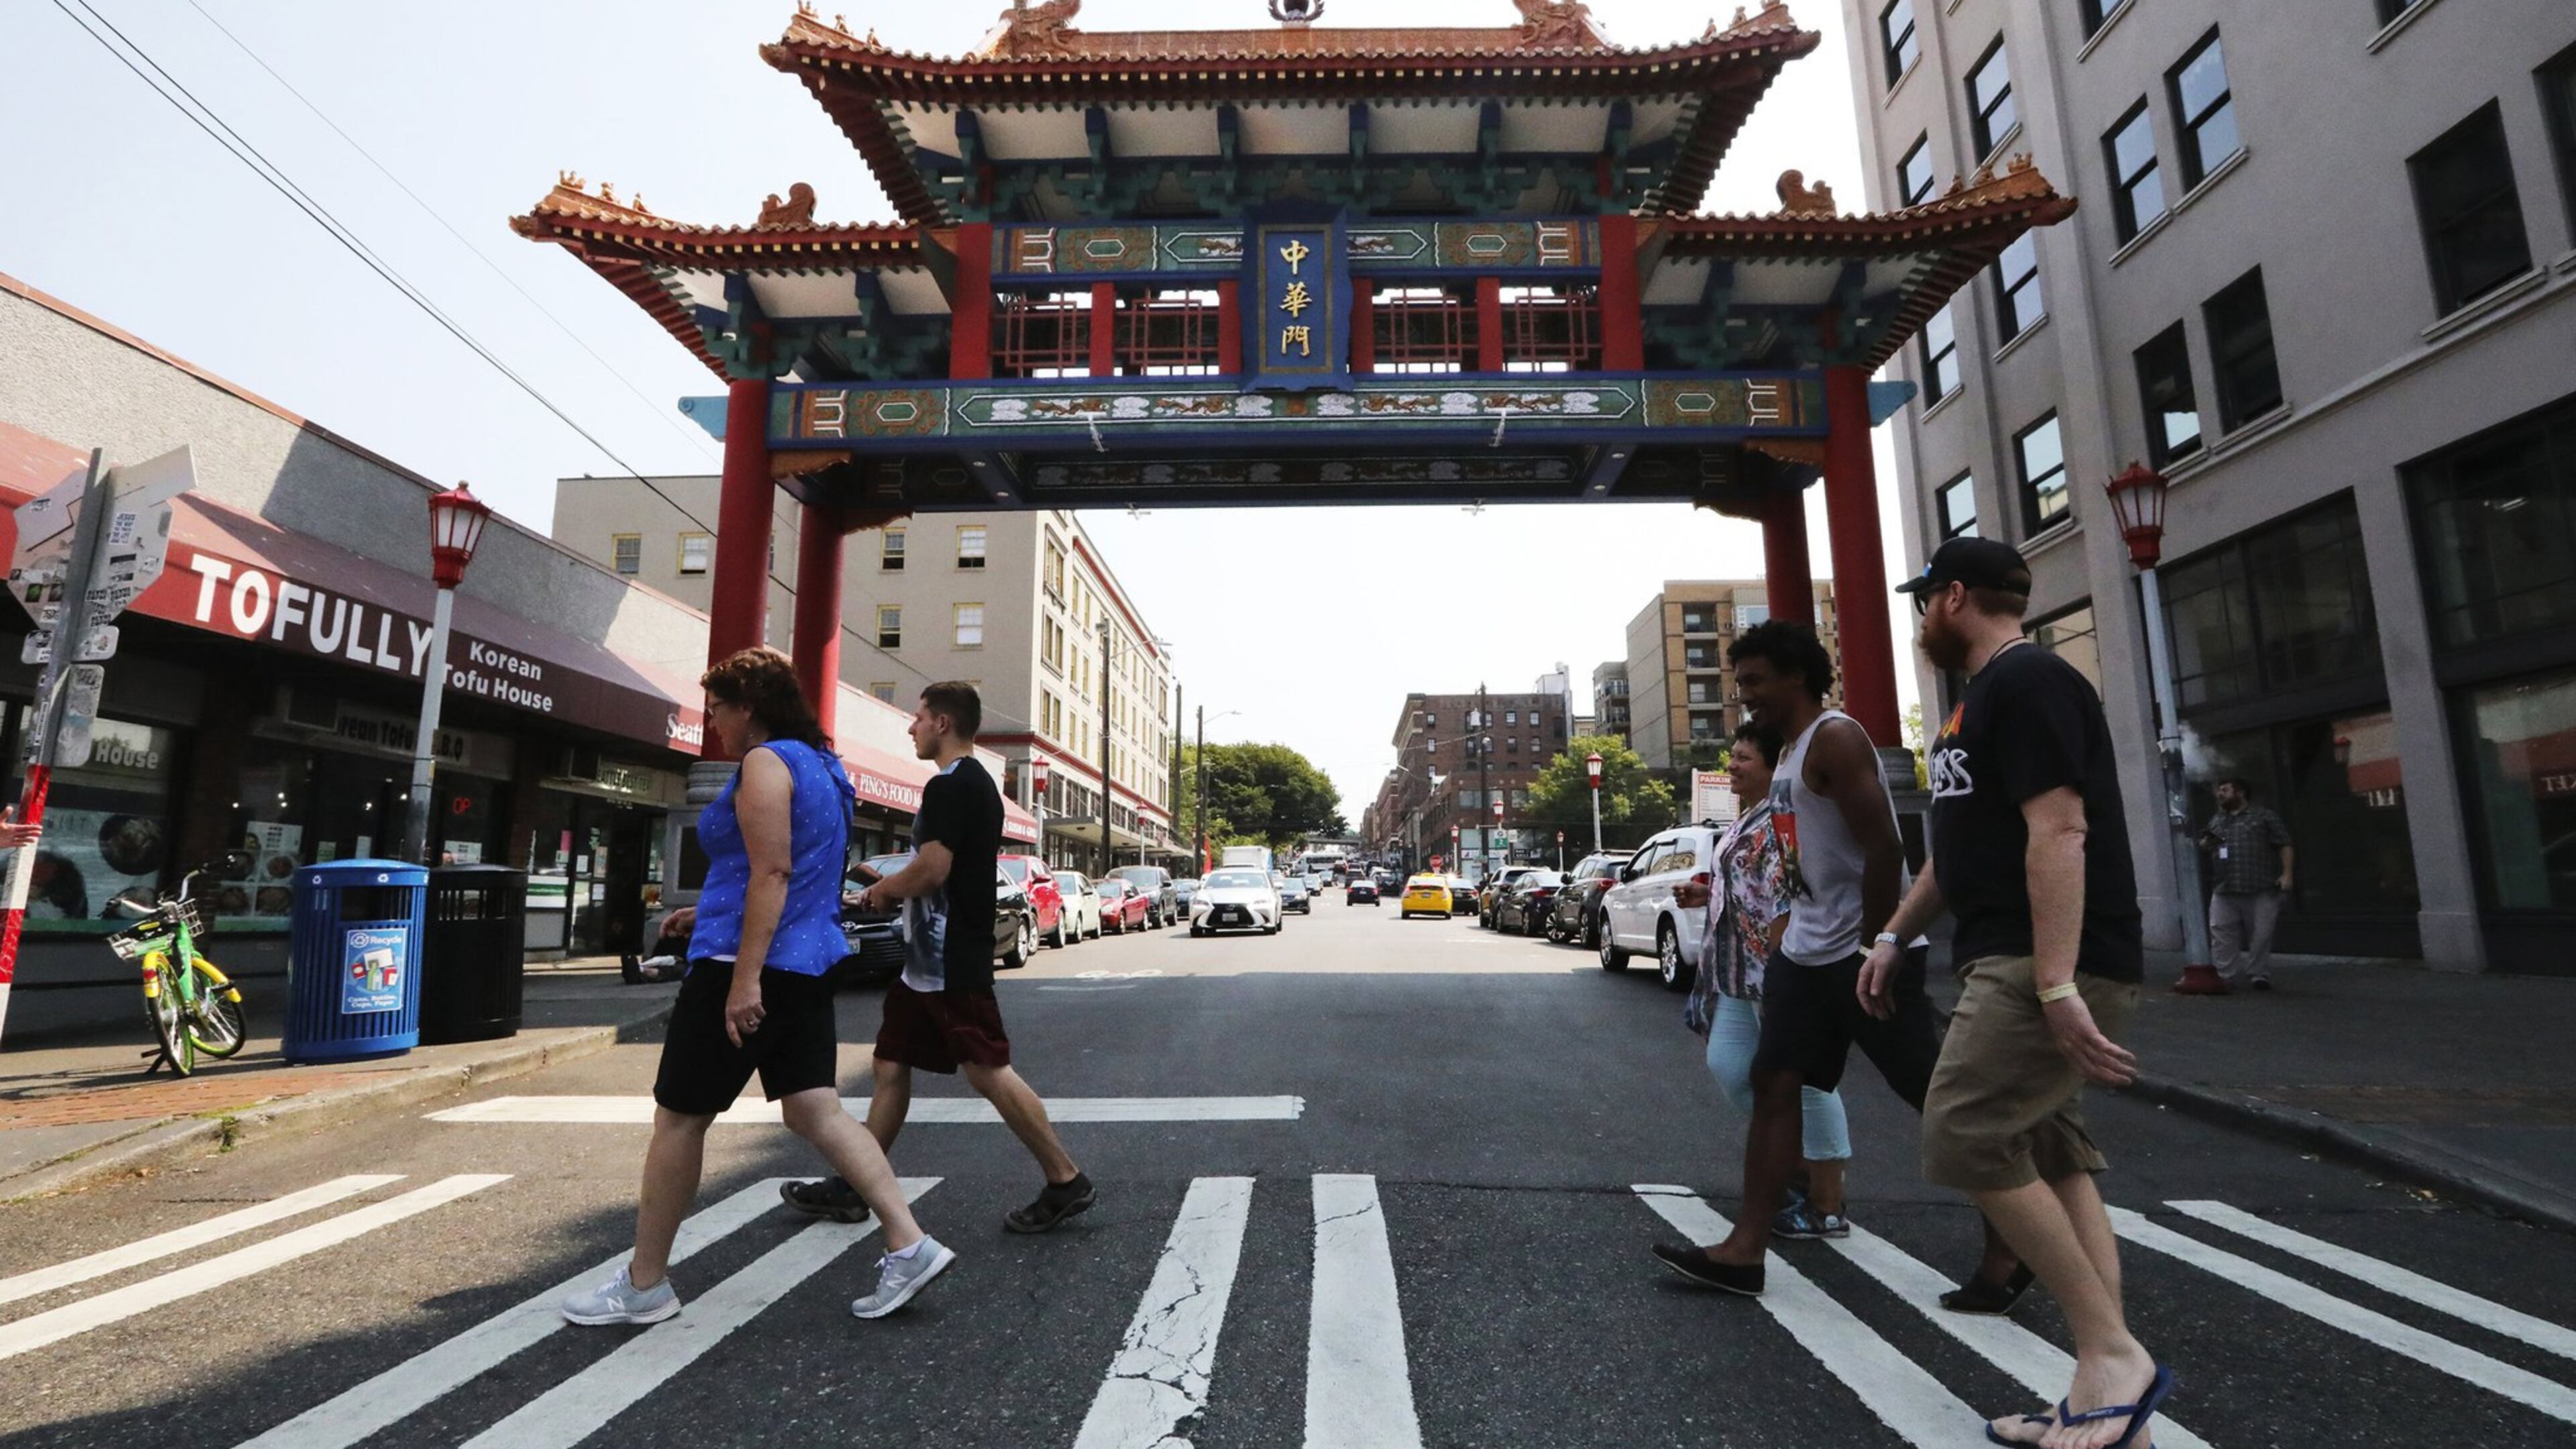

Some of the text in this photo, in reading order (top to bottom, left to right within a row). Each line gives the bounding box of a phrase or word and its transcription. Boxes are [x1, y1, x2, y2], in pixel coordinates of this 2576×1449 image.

[1279, 239, 1313, 356] 中華門
[191, 553, 433, 676] TOFULLY
[470, 641, 542, 681] Korean
[492, 678, 553, 712] House
[338, 715, 378, 742] rean
[95, 741, 158, 769] House
[859, 773, 890, 799] PING'S
[890, 783, 912, 805] FOOD
[1700, 775, 1731, 784] PARKIN
[370, 935, 402, 945] Recycle
